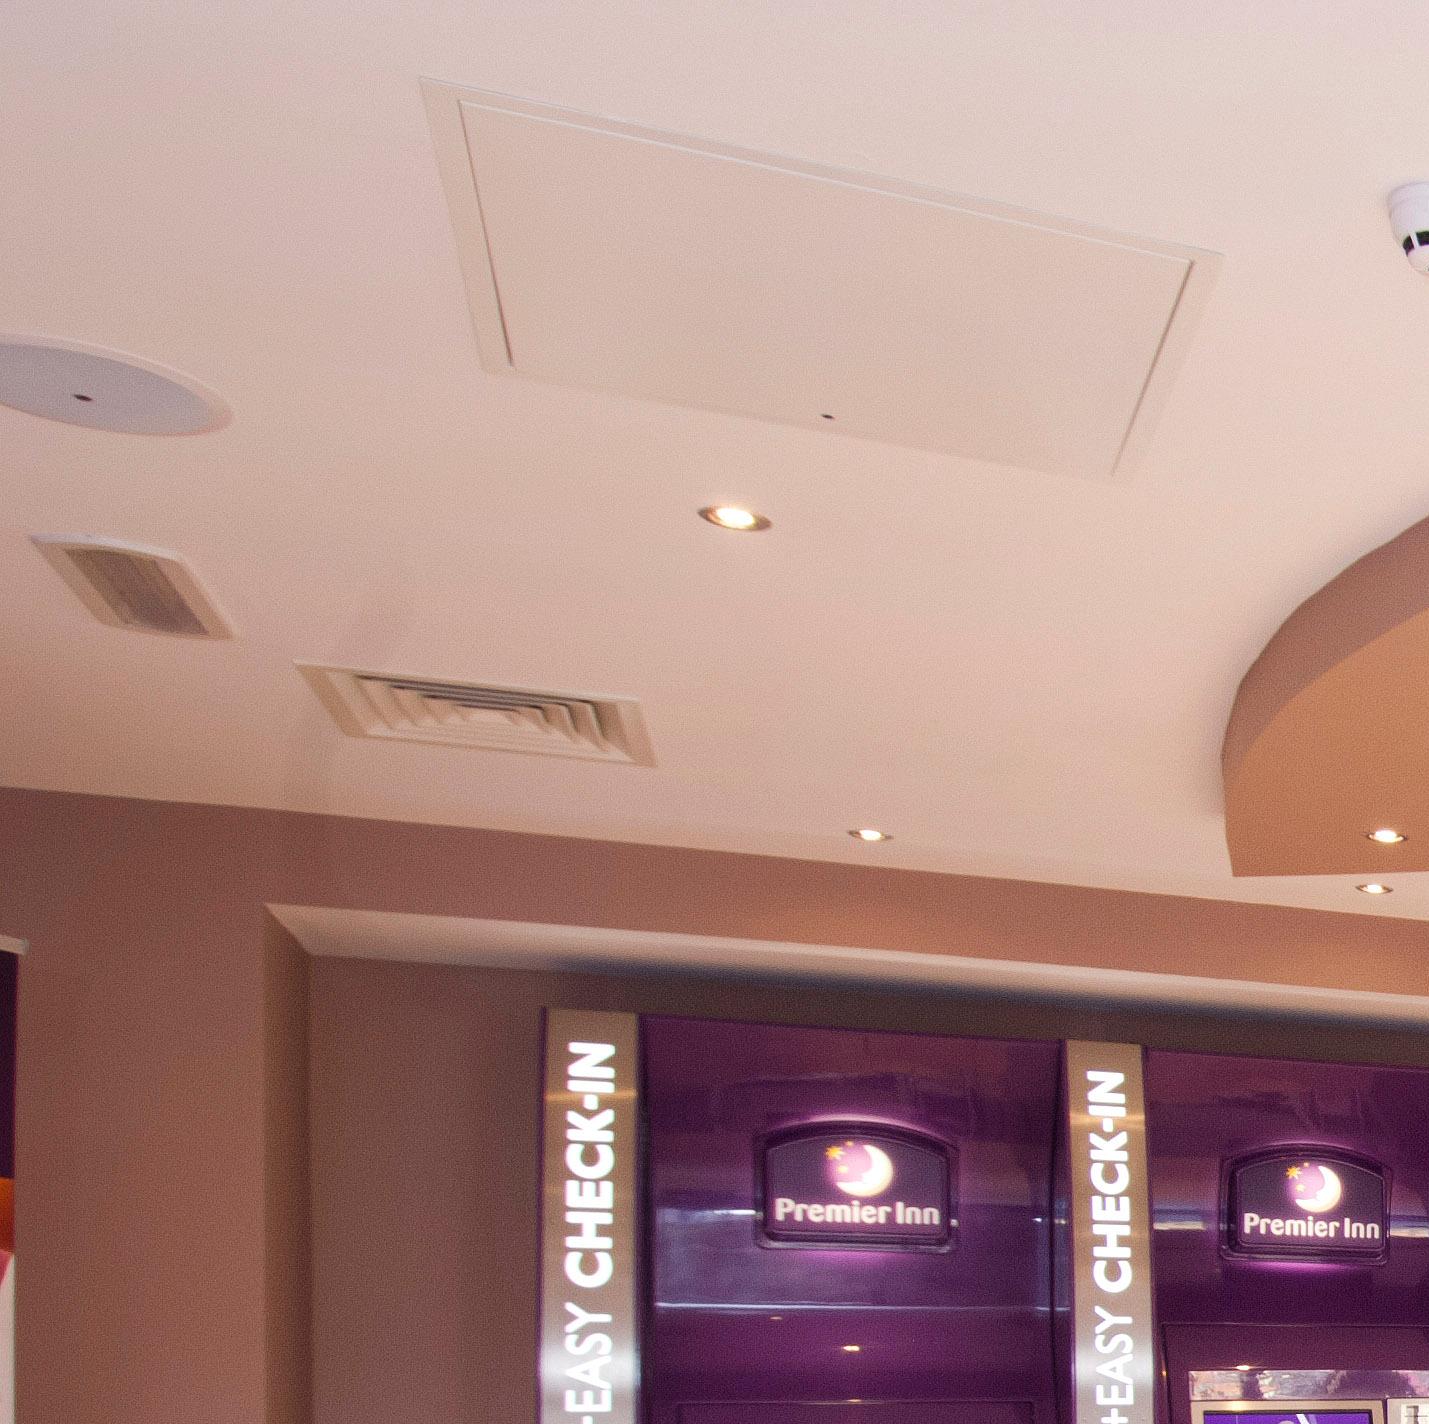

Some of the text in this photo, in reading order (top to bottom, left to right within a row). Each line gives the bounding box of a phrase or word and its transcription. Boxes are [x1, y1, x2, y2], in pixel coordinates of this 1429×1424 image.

[565, 1041, 616, 1289] CHECK-IN
[775, 1197, 942, 1226] Premier Inn
[1086, 1069, 1132, 1295] CHECK-IN
[1243, 1212, 1380, 1239] Premier Inn
